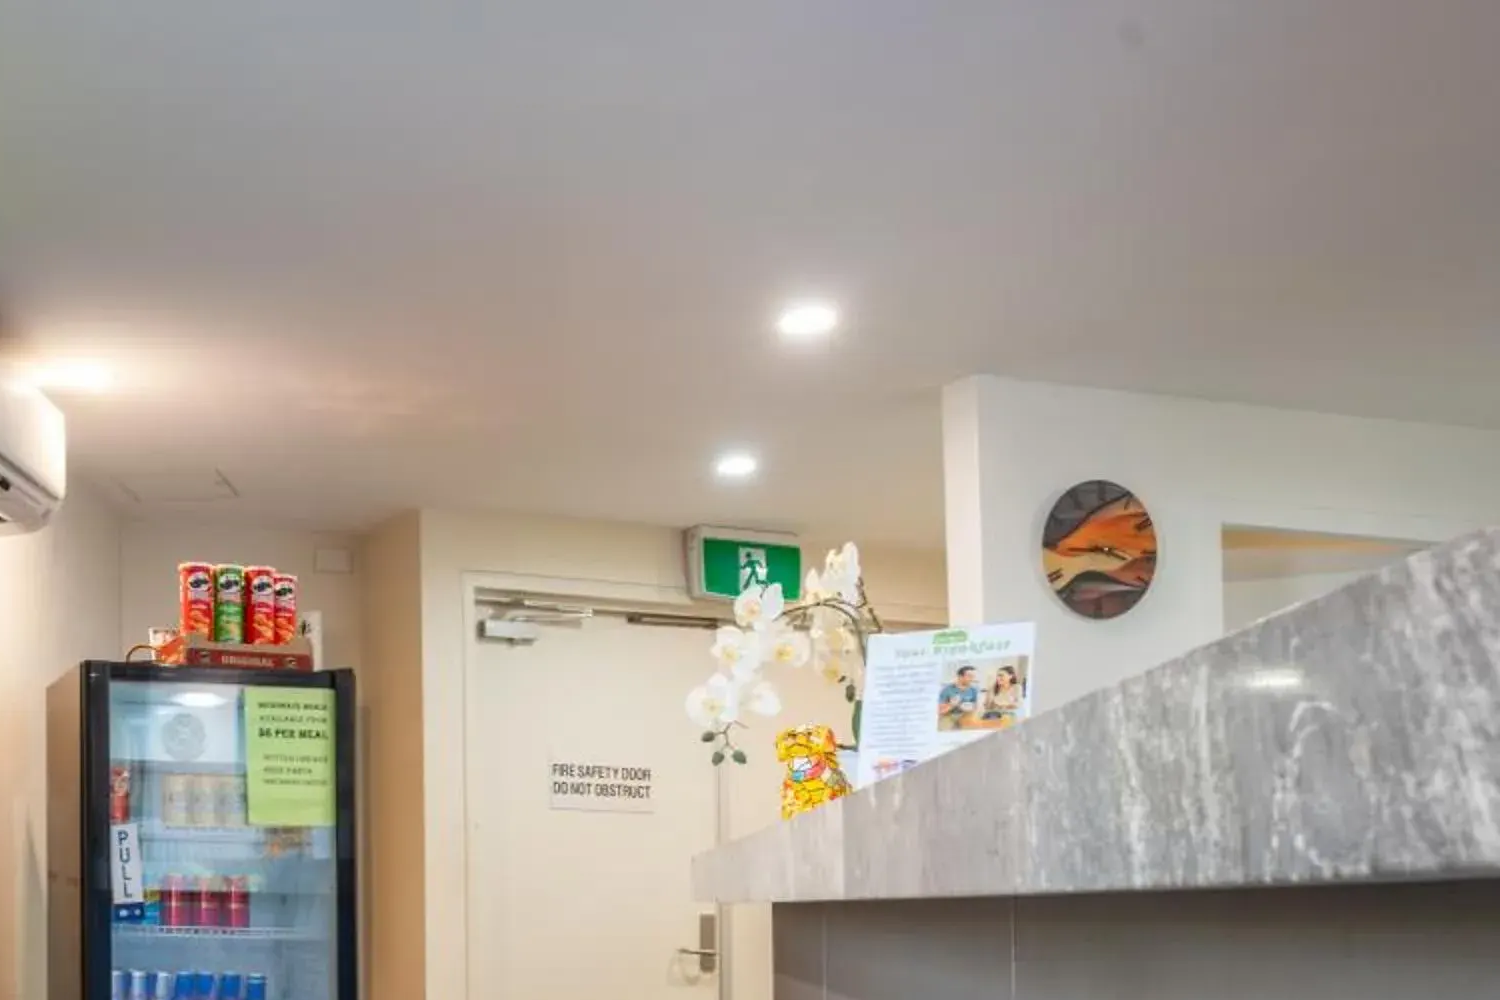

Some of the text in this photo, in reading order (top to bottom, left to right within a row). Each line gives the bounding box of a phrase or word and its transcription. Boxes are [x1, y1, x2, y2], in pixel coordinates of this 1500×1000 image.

[552, 763, 652, 782] FIRE SAFETY DOOR
[553, 781, 652, 799] DO NOT OBSTRUCT
[117, 829, 133, 899] PULL
